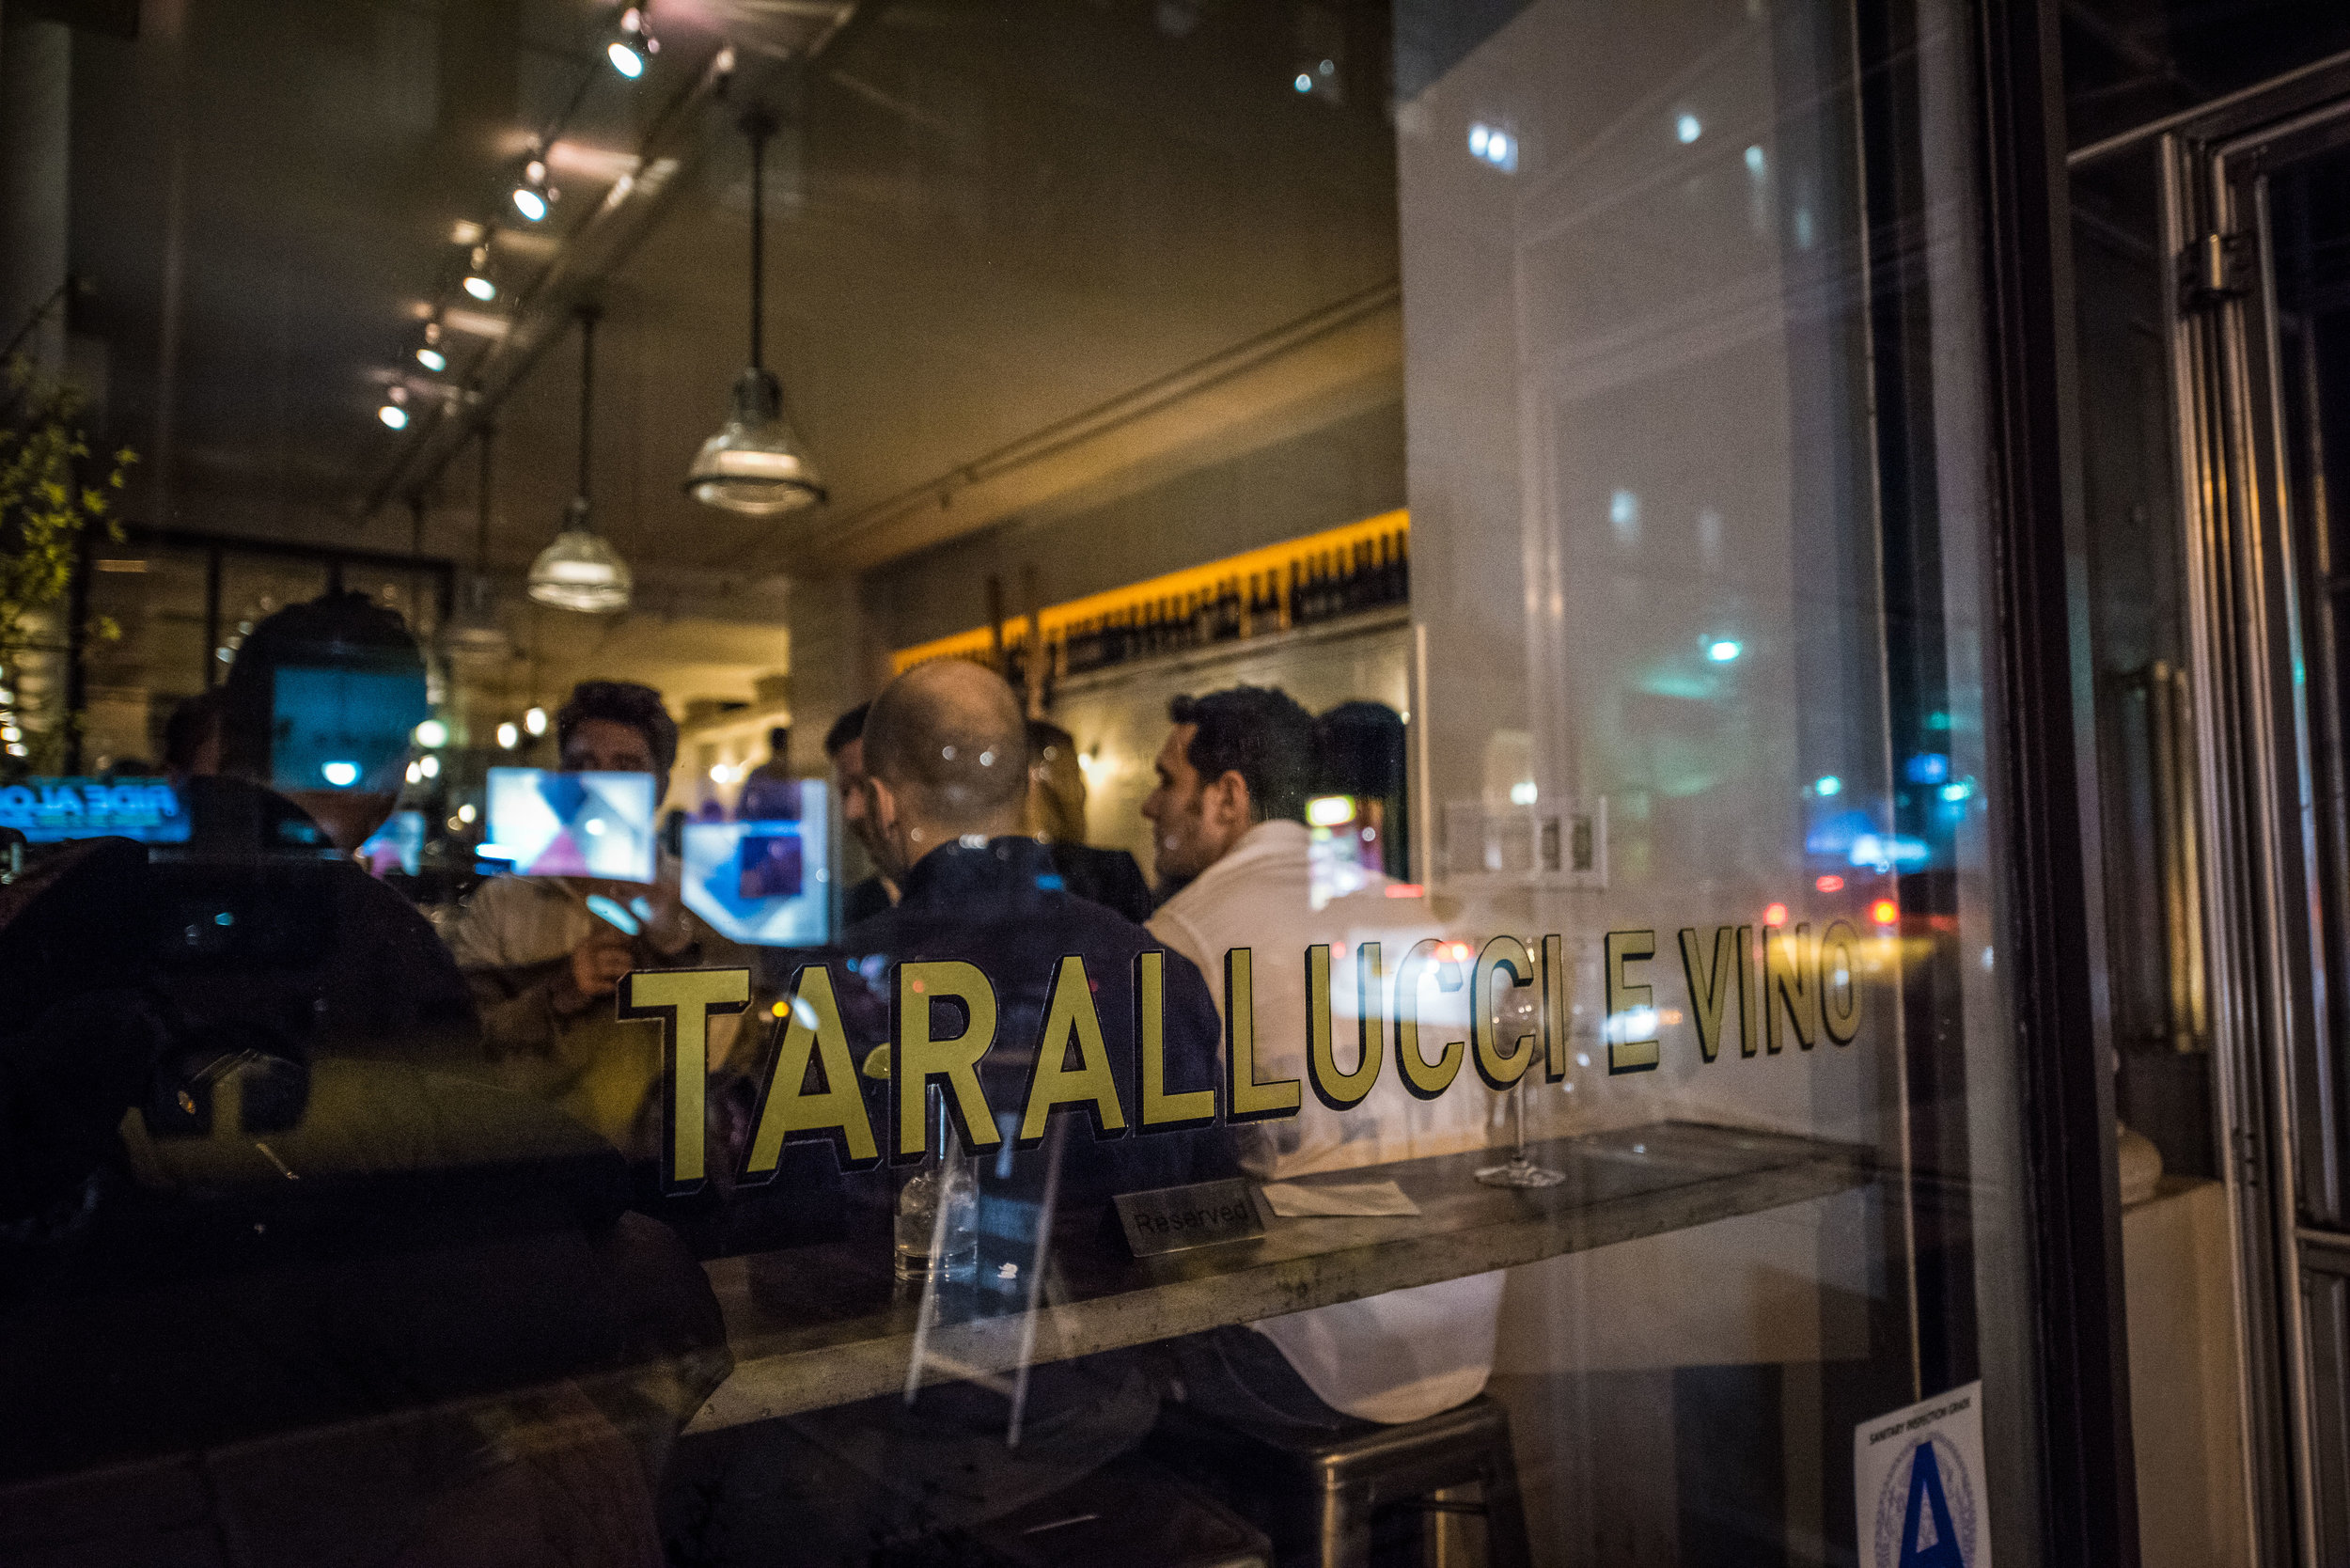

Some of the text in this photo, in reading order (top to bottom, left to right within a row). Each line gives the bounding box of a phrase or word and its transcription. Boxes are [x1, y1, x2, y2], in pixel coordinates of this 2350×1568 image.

[617, 918, 1863, 1197] TARALLUCCI E VINO
[1134, 1197, 1249, 1237] Reserved
[1870, 1423, 1905, 1446] SANITARY
[1898, 1440, 1966, 1568] A
